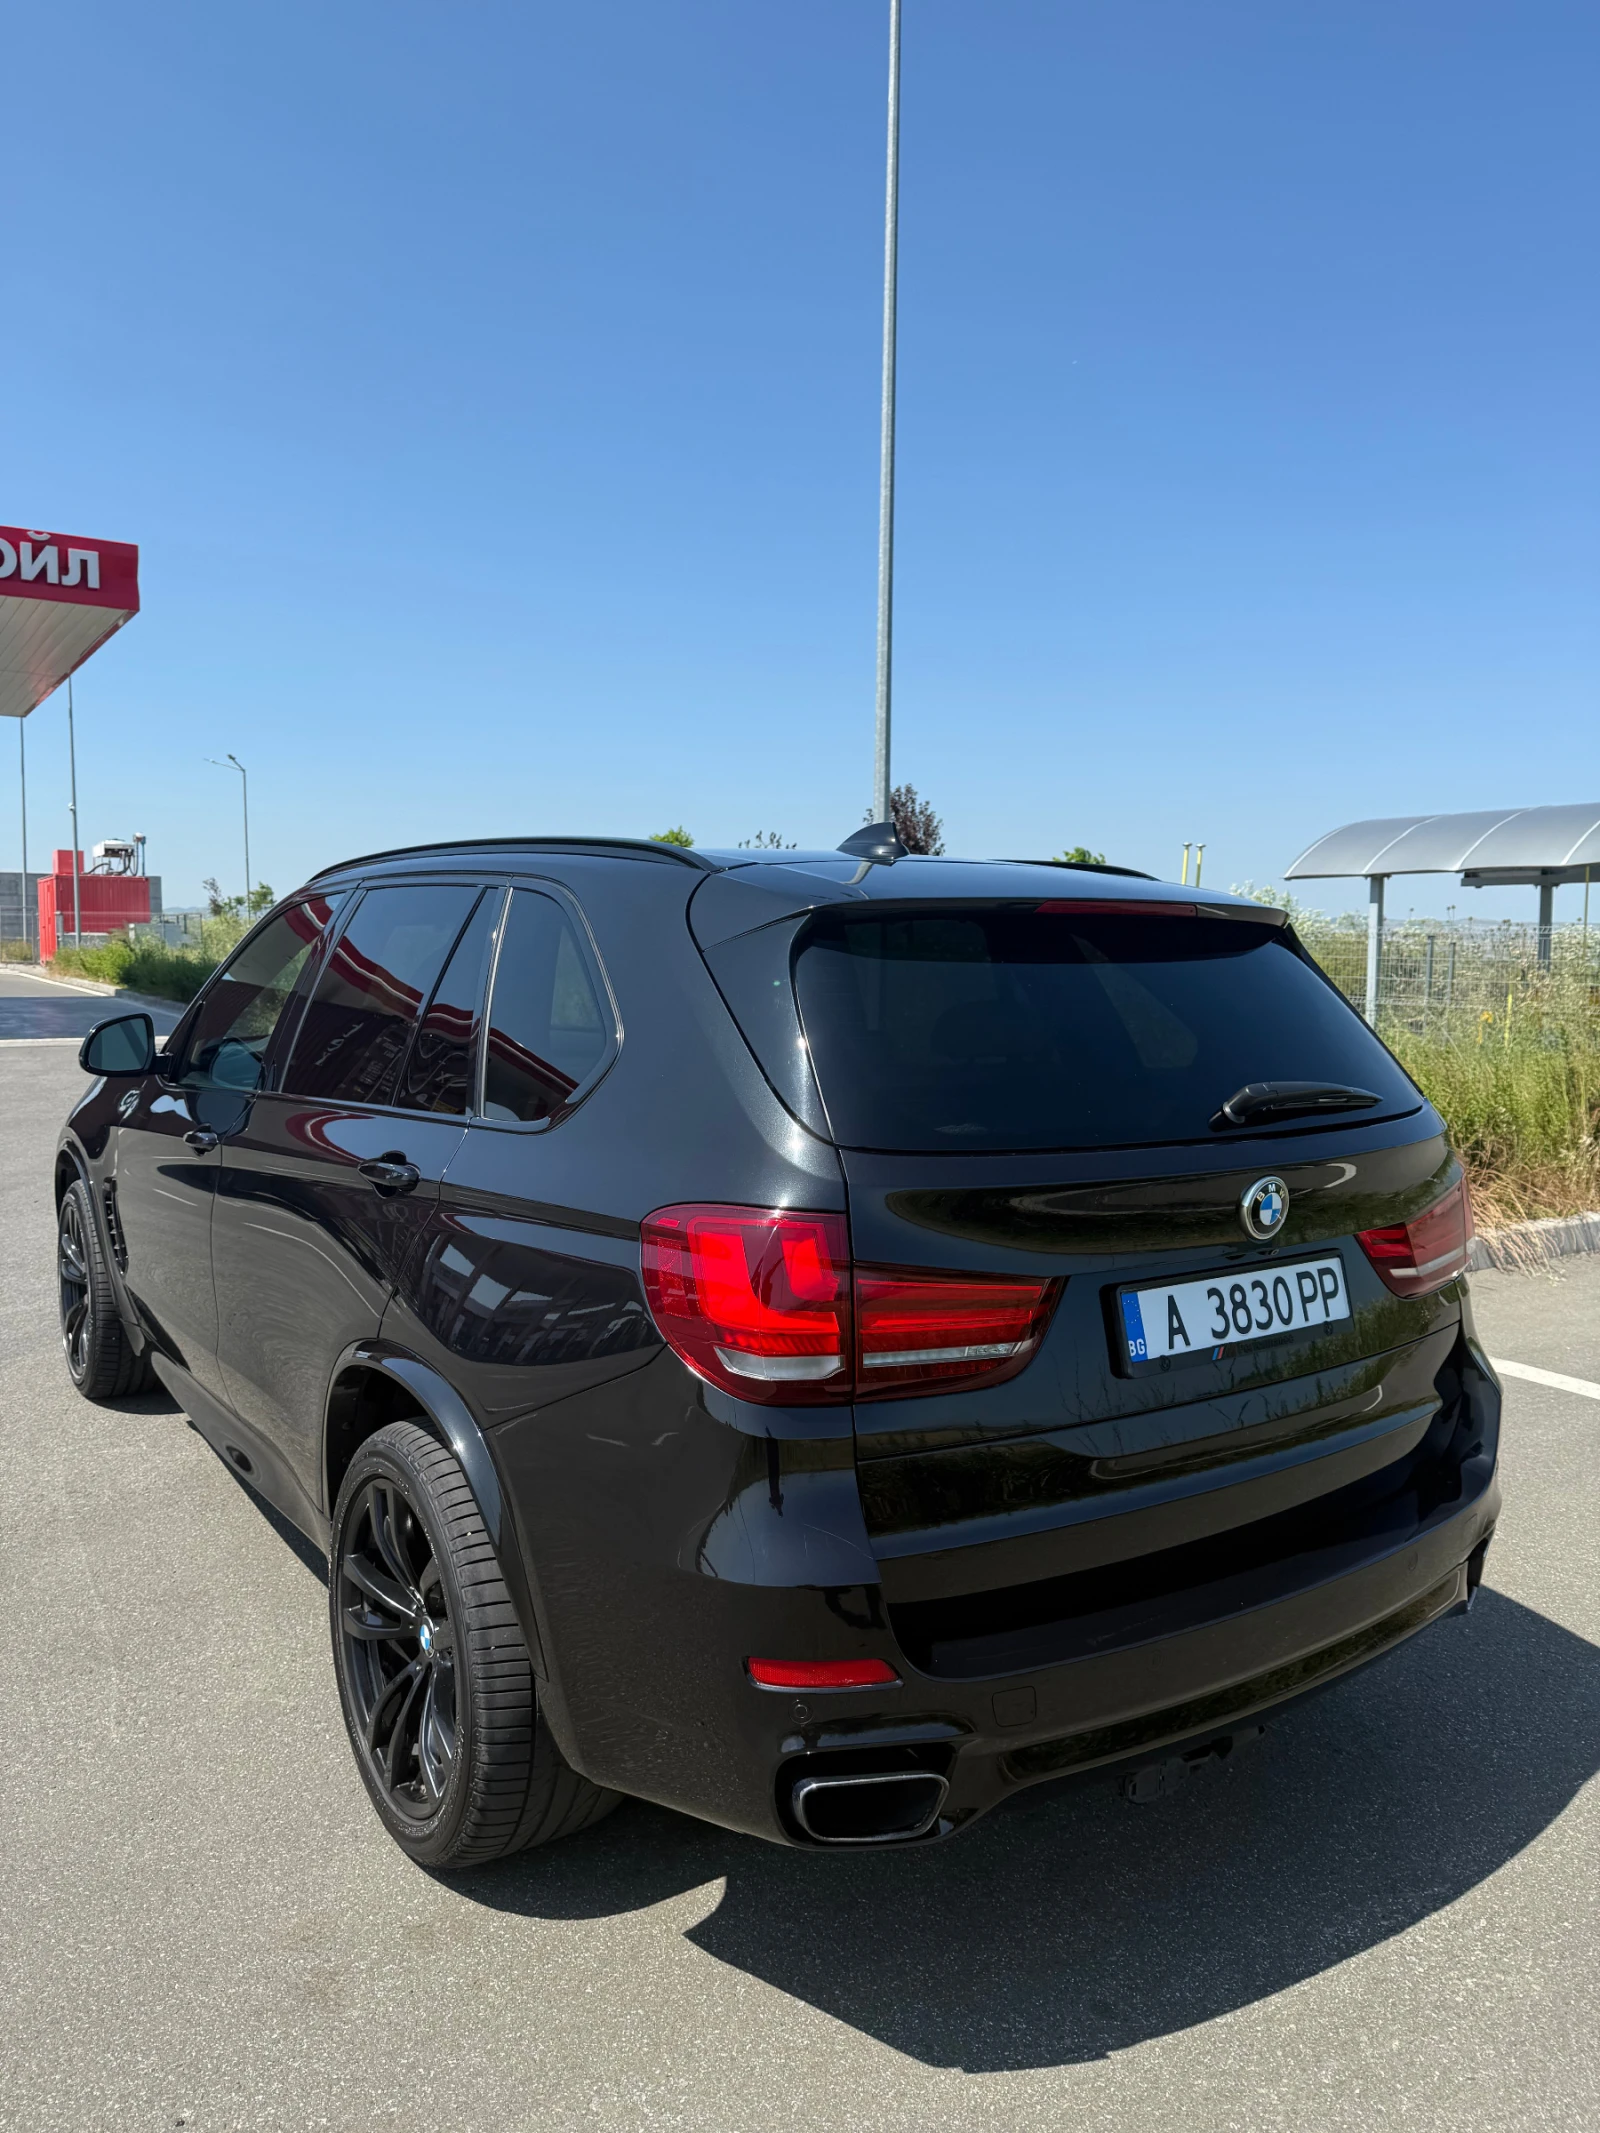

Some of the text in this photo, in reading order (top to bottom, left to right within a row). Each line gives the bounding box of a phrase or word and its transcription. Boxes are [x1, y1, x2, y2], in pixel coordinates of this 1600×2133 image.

[1257, 1184, 1285, 1201] BMW
[1168, 1295, 1191, 1349] A
[1128, 1338, 1145, 1356] BG
